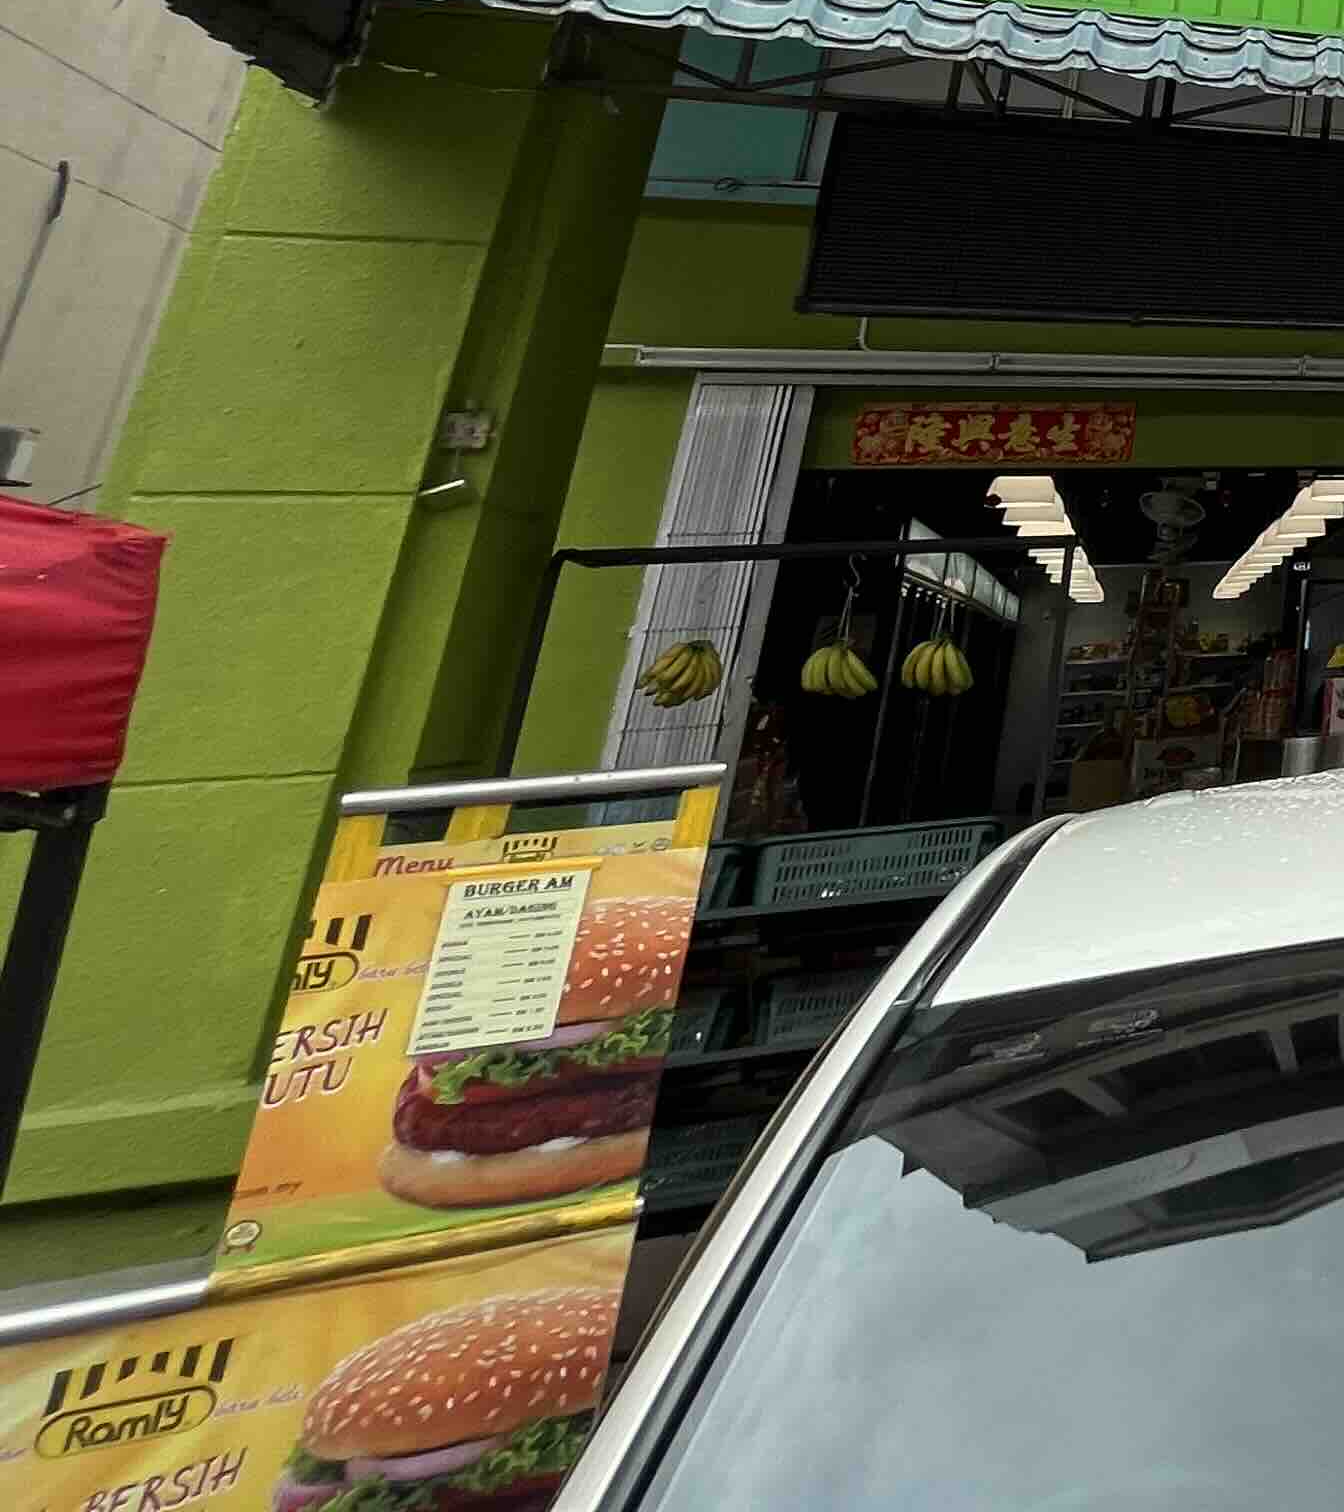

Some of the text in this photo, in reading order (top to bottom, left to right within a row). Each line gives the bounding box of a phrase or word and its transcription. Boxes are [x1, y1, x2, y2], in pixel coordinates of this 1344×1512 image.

[373, 855, 455, 878] Menu
[463, 874, 576, 898] BURGER AM
[63, 1394, 190, 1454] Ramly
